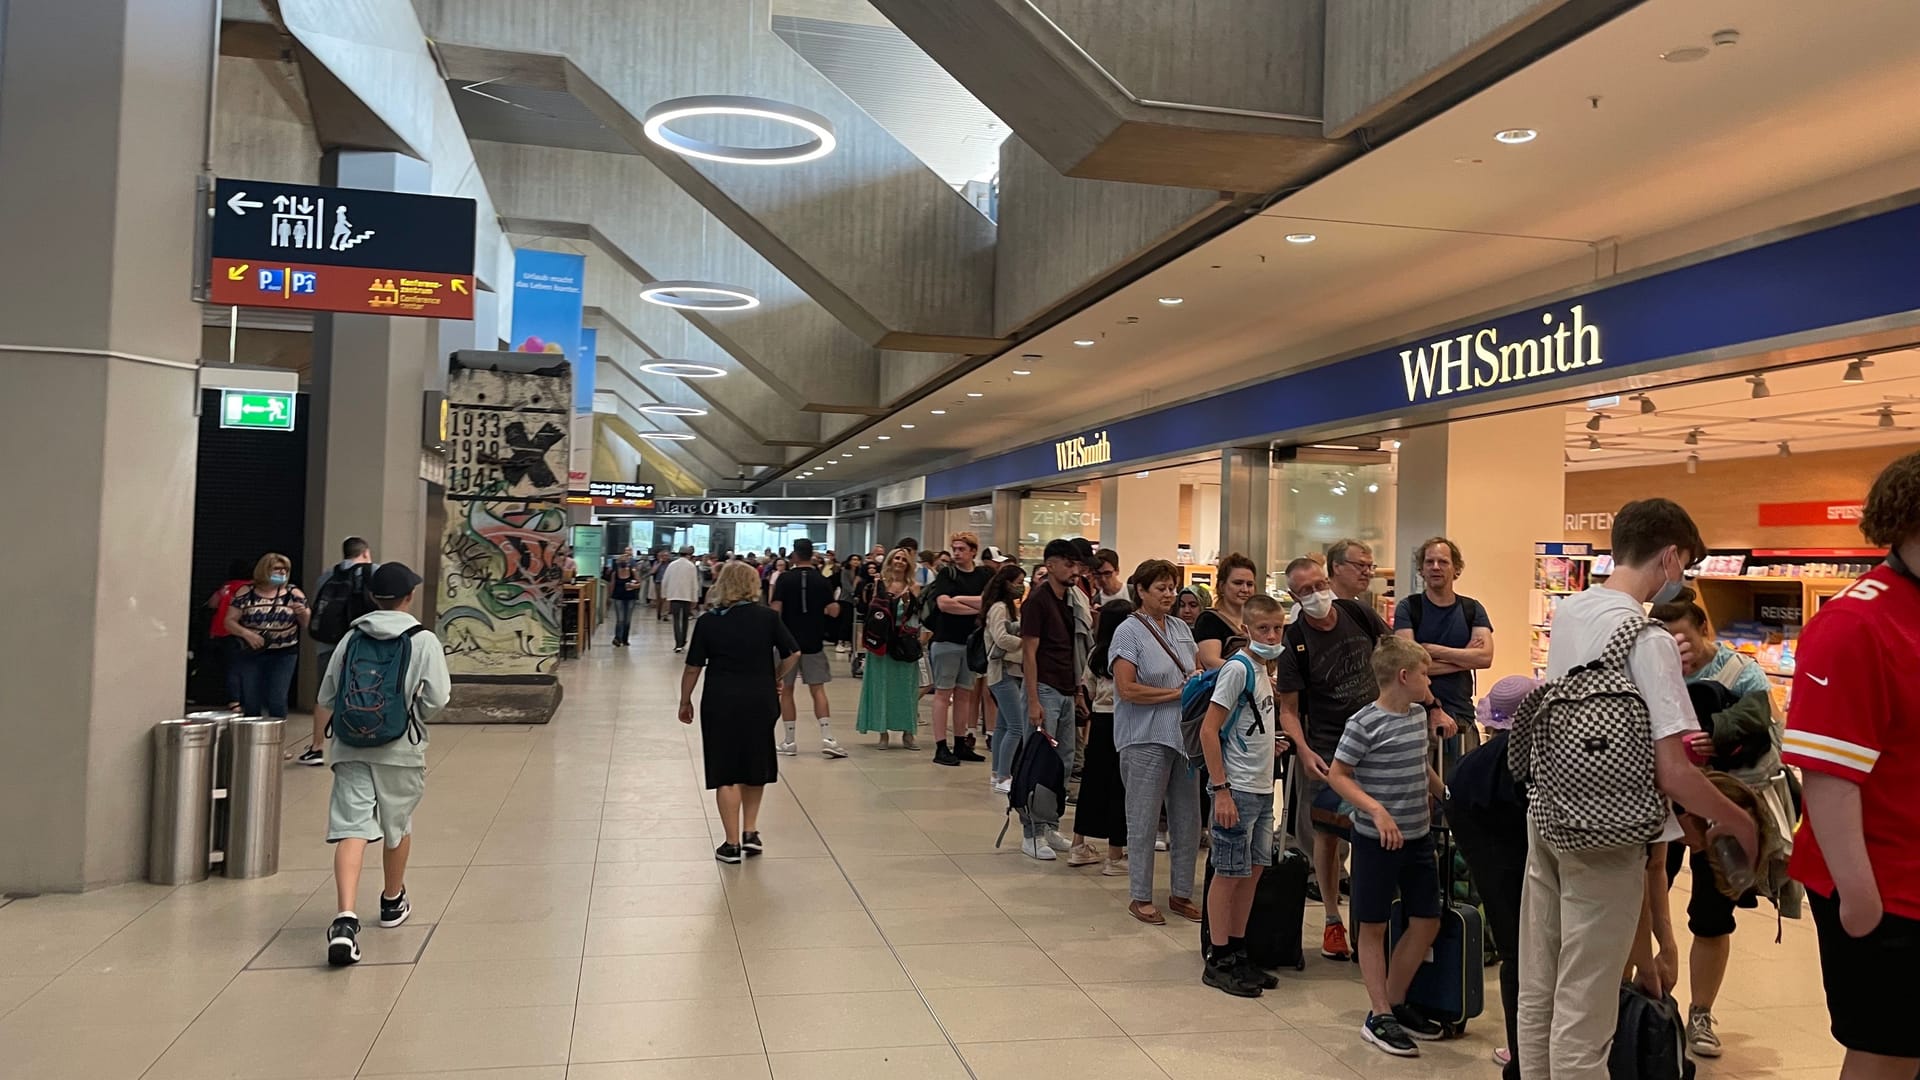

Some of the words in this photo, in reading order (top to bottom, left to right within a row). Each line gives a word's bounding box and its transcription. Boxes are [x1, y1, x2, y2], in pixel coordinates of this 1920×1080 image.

[529, 282, 553, 291] Leben
[1399, 304, 1604, 402] WHSmith
[451, 411, 501, 438] 1933
[1055, 430, 1112, 472] WHSmith
[449, 466, 499, 491] 1945
[656, 501, 697, 514] Marc
[700, 501, 757, 515] O'Polo
